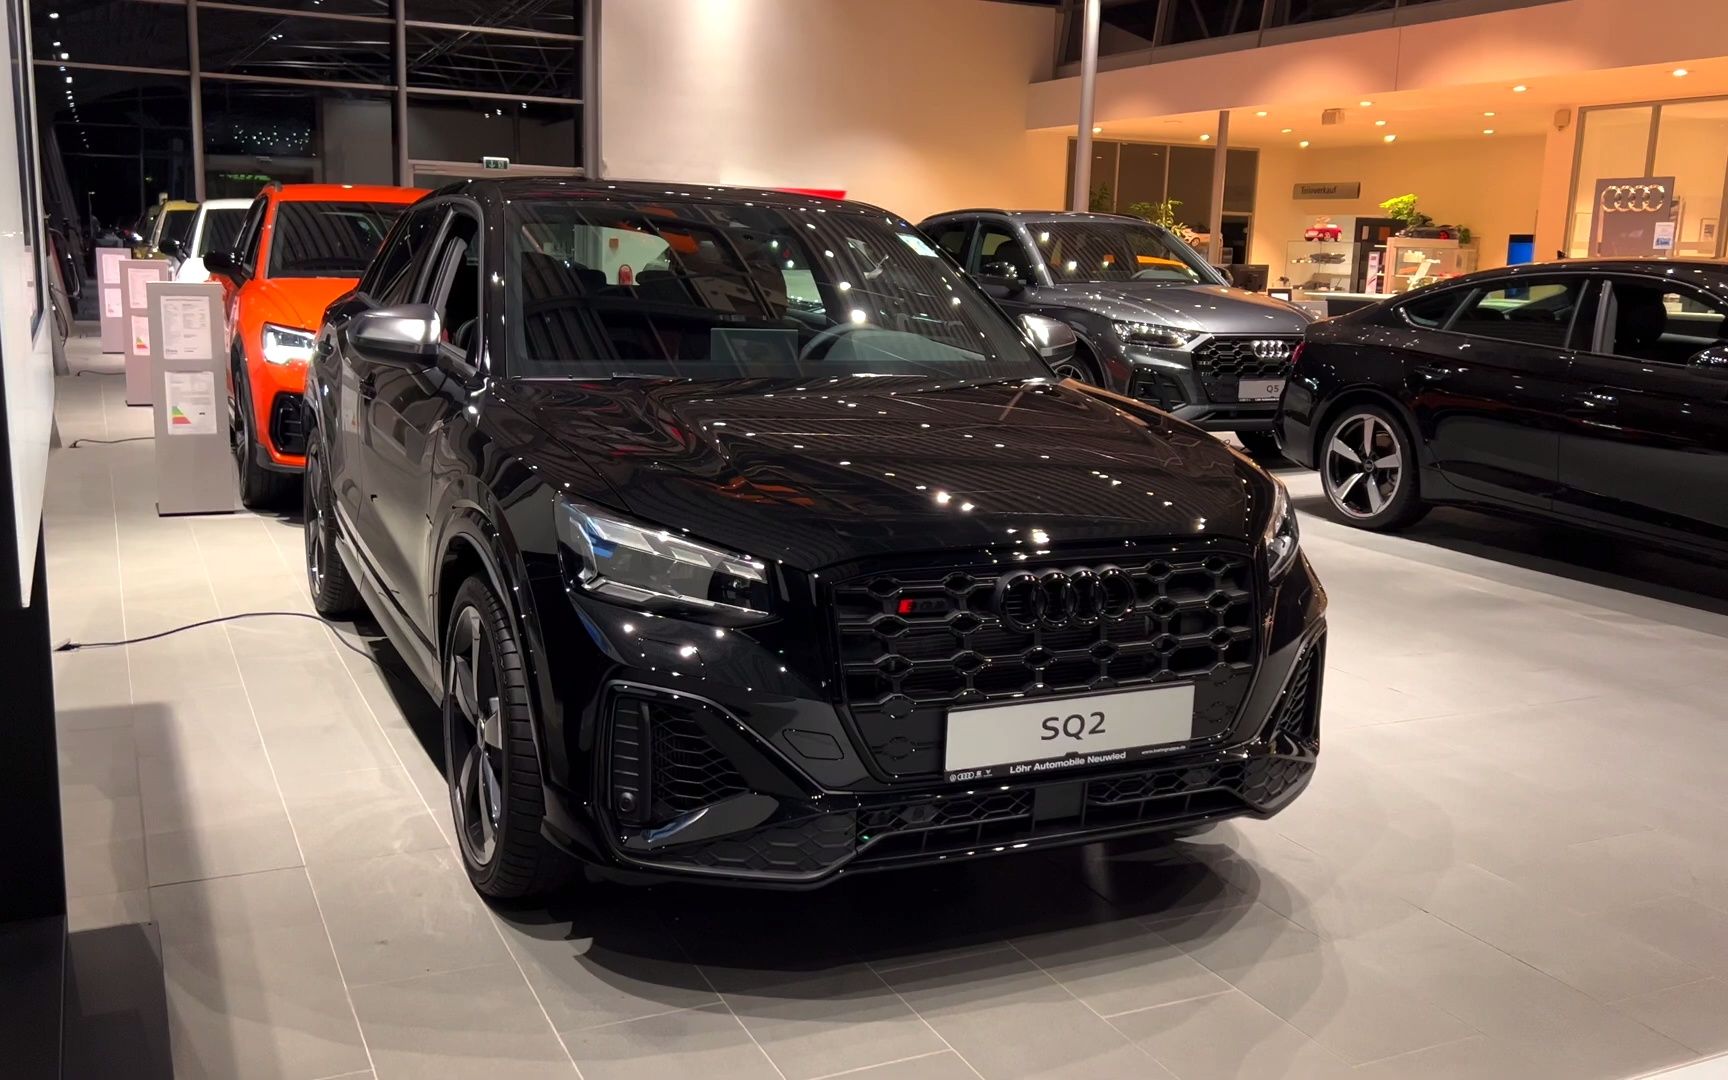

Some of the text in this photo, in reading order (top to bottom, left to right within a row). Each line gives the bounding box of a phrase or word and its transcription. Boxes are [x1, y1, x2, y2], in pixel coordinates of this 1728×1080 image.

[1266, 384, 1280, 393] Q5
[1041, 711, 1106, 740] SQ2
[1009, 751, 1127, 774] Löhr Automobile Neuwied
